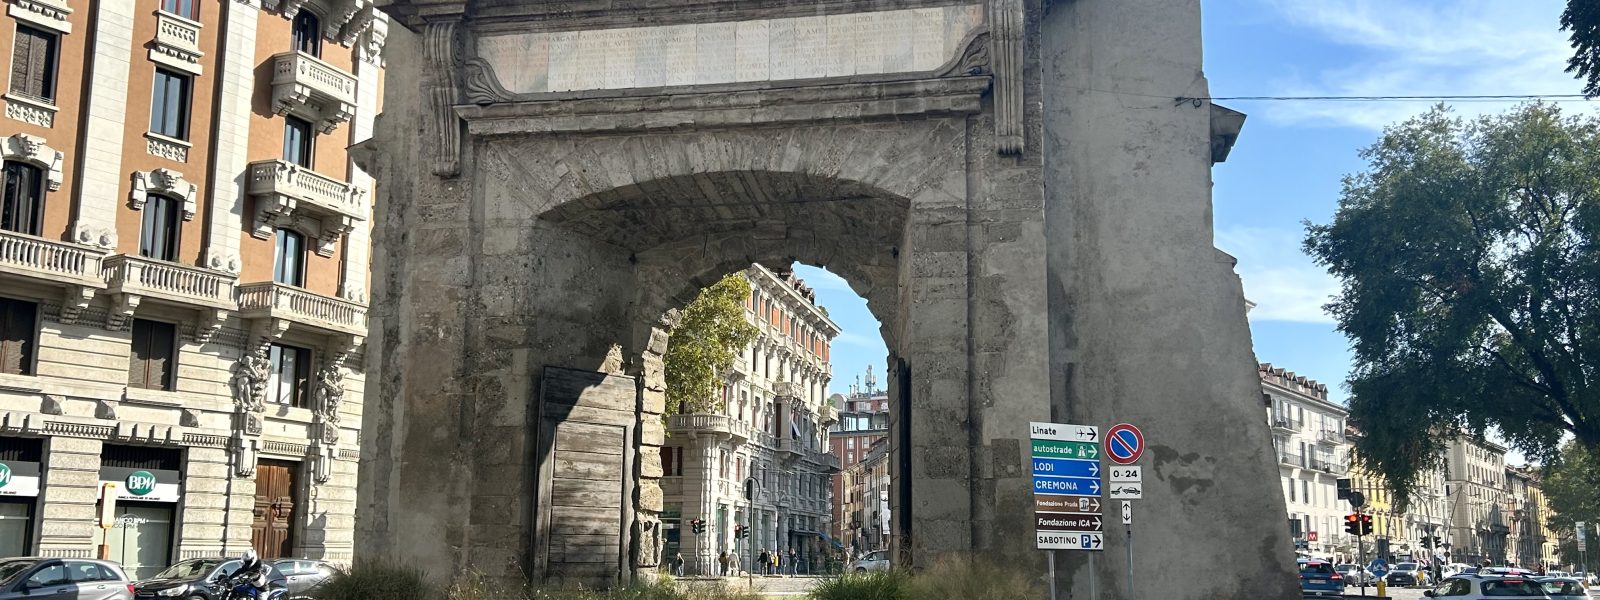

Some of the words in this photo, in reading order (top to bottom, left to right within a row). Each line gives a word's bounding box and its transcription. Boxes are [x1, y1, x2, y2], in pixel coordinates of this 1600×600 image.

[1032, 426, 1057, 436] Linate
[1034, 444, 1072, 454] autostrade
[1034, 462, 1054, 472] LODI
[129, 476, 156, 490] BPM
[1036, 480, 1078, 490] CREMONA
[1038, 518, 1077, 526] Fondazione
[1039, 536, 1077, 544] SABOTINO
